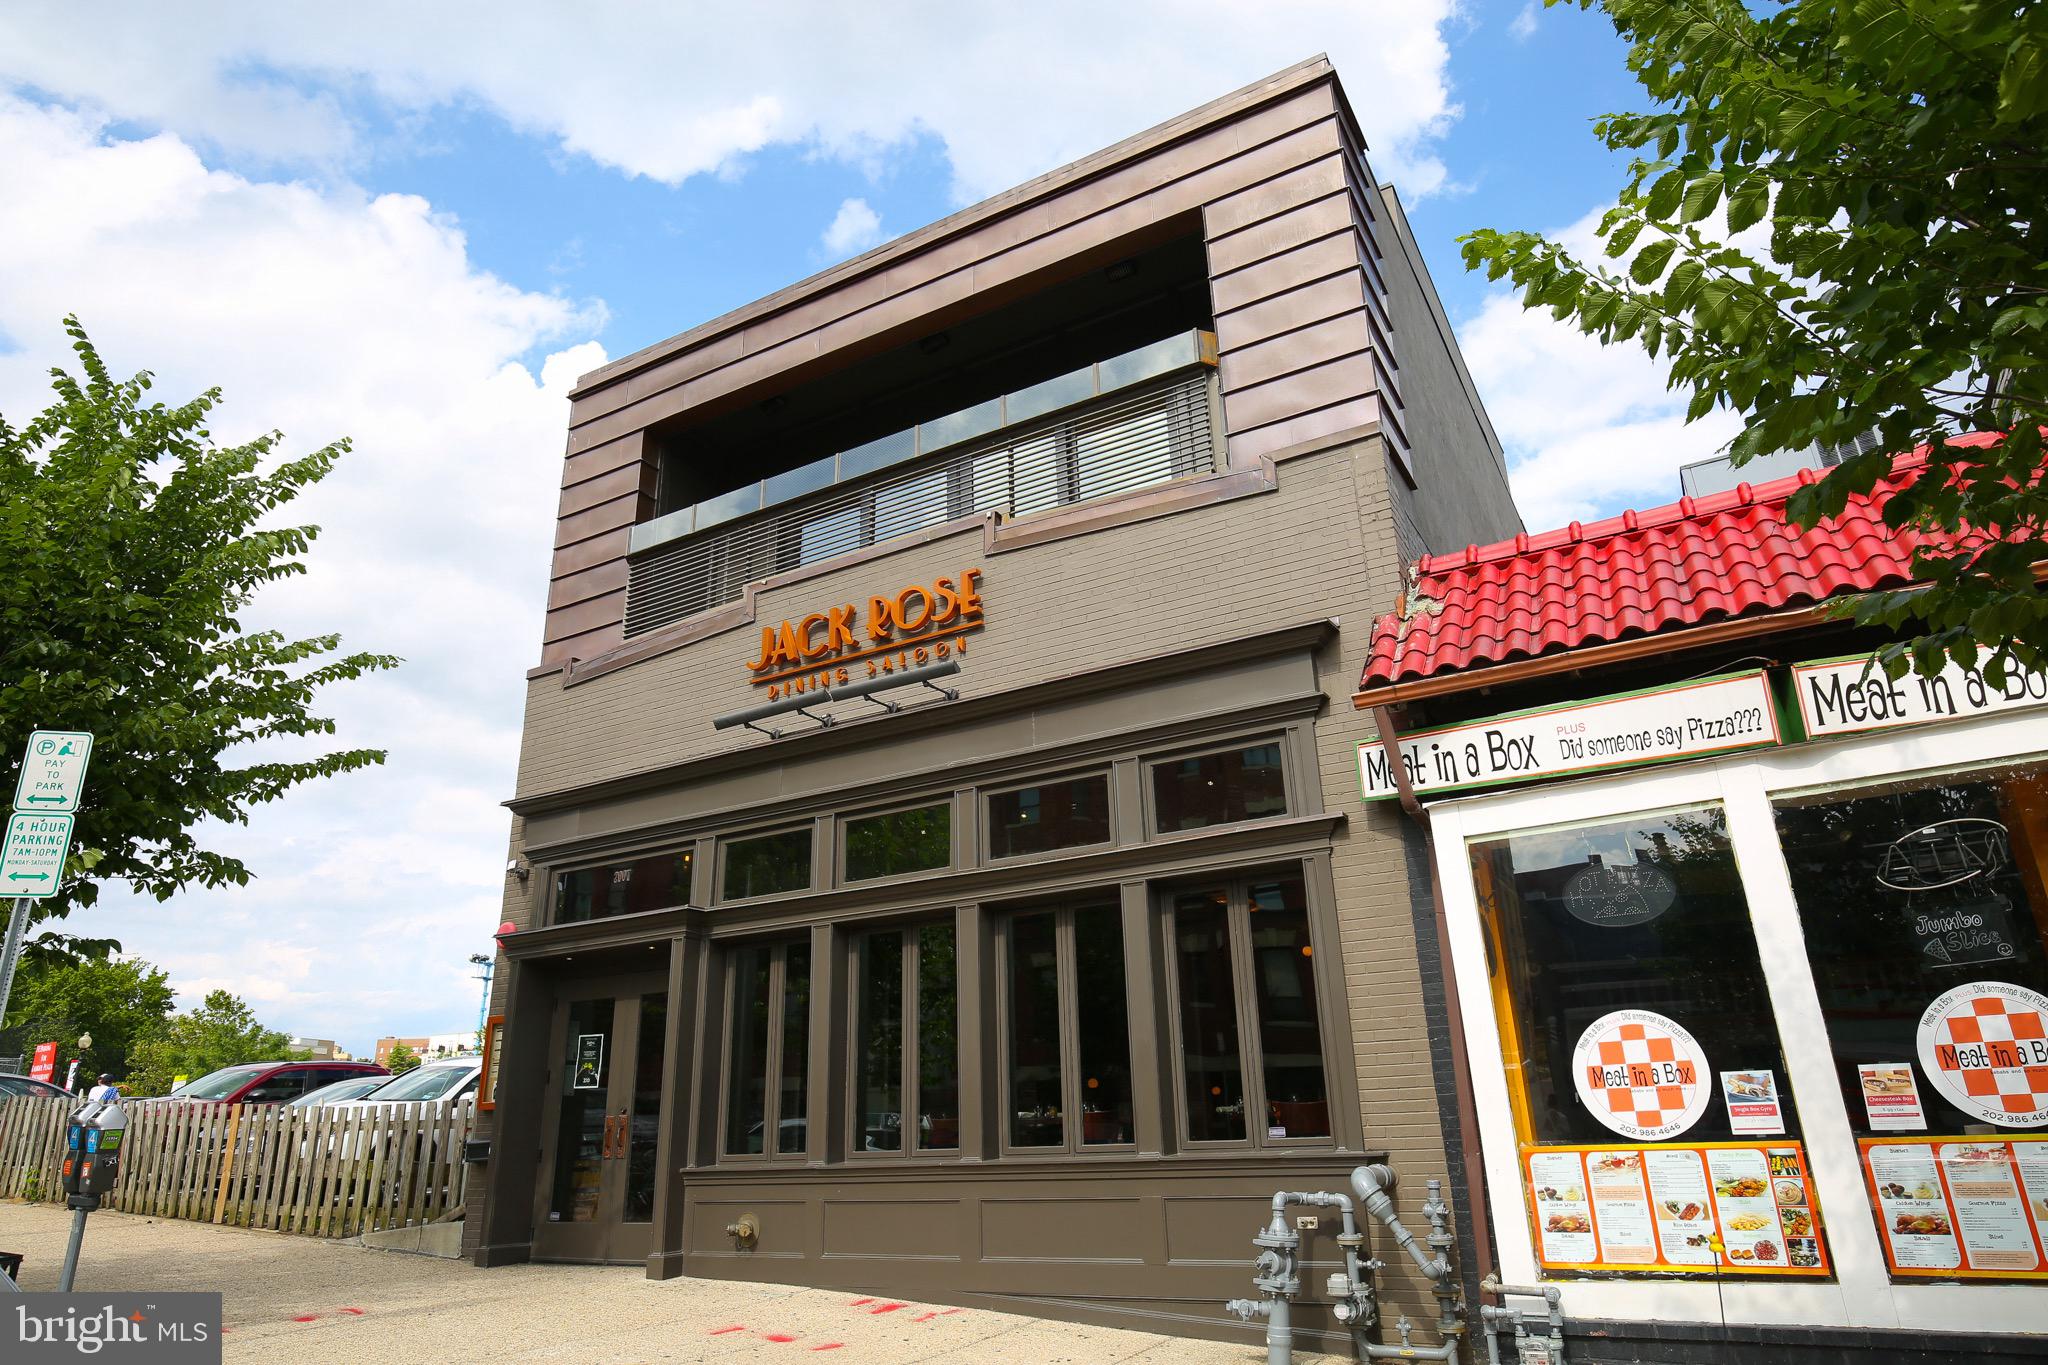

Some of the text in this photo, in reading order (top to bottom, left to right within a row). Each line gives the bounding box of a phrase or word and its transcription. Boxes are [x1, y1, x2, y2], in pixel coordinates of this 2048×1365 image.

[746, 567, 984, 672] JACK ROSE
[768, 636, 967, 701] DINING SALOON
[1808, 671, 1906, 726] Meat
[1914, 668, 1958, 716] in
[1964, 667, 1989, 708] a
[1555, 722, 1587, 736] PLUS
[1559, 707, 1763, 760] Did someone say Pizza???
[45, 760, 66, 768] PAY
[1431, 743, 1460, 783] in
[1465, 739, 1481, 778] a
[1485, 730, 1540, 772] Box
[47, 771, 60, 779] TO
[35, 782, 65, 791] PARK
[16, 821, 66, 833] 4 HOUR
[12, 834, 64, 846] PARKING
[13, 848, 58, 857] 7AM-10PM
[1916, 910, 1982, 935] Jumbo
[2033, 994, 2048, 1010] Piz
[1941, 1041, 2048, 1068] Meat in a B
[1592, 1064, 1693, 1088] Meat in a Box
[1620, 1122, 1681, 1136] 202.986.4646
[89, 1132, 96, 1144] 4
